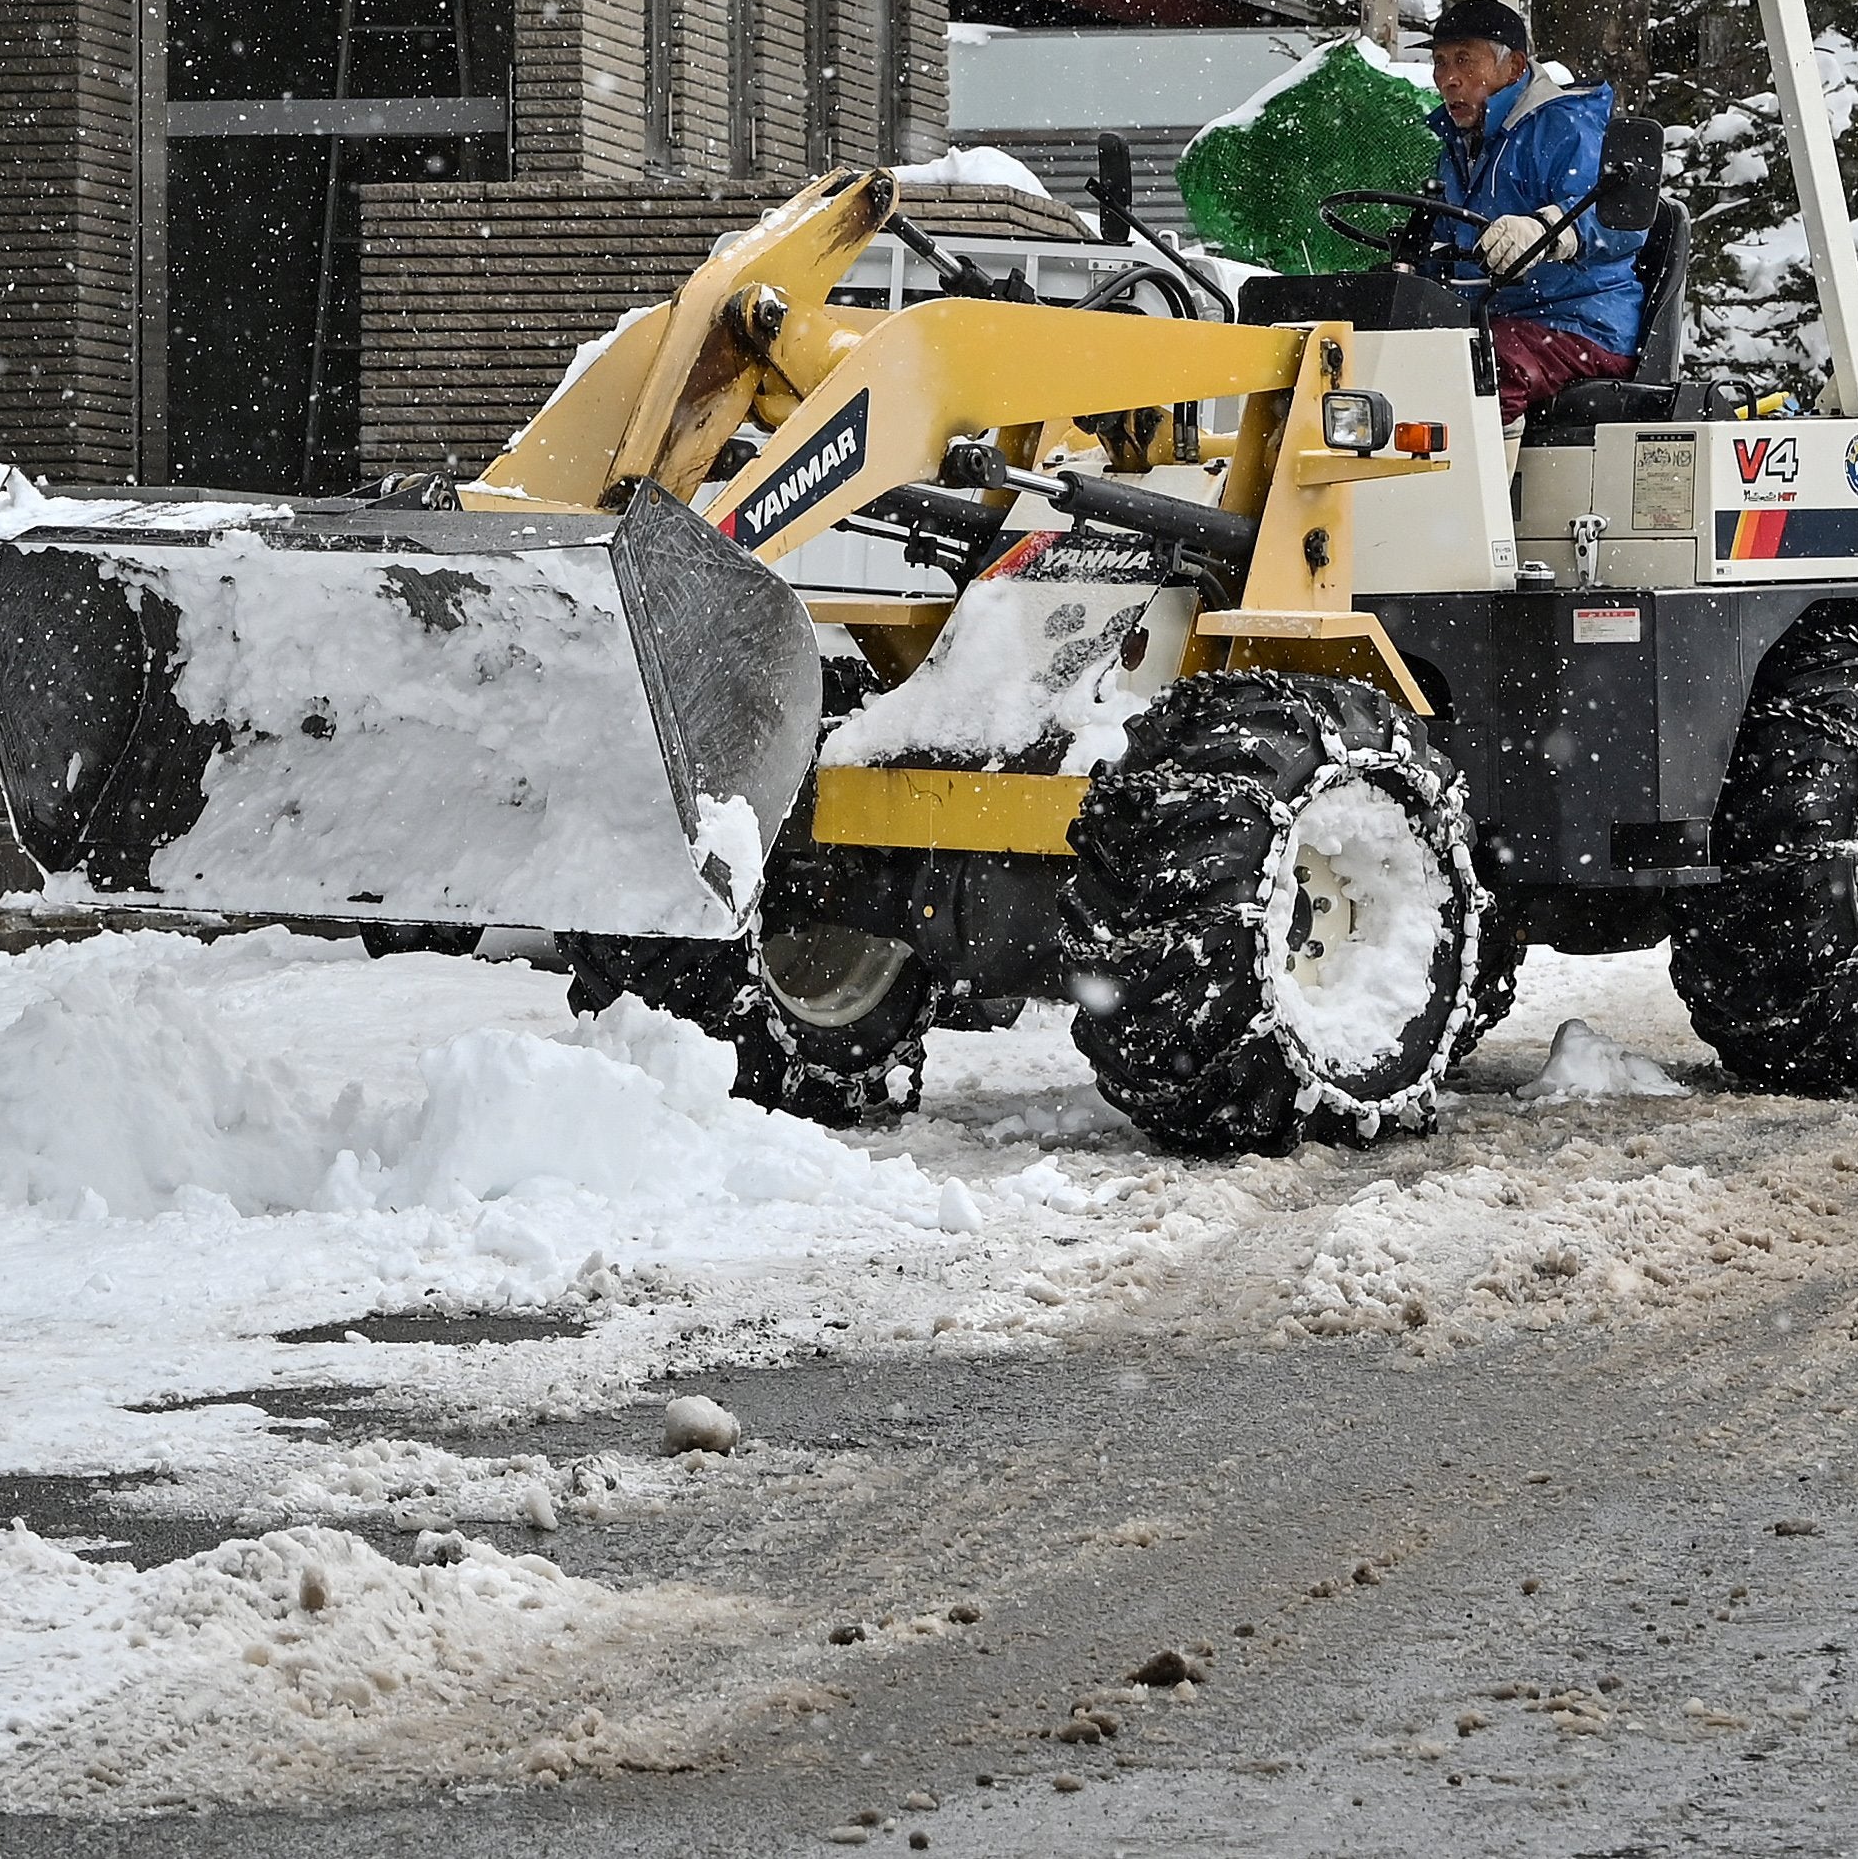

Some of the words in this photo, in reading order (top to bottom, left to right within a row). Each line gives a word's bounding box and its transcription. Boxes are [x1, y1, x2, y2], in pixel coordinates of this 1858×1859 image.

[744, 426, 858, 534] YANMAR
[1733, 437, 1799, 484] V4
[1041, 547, 1153, 570] YANMA
